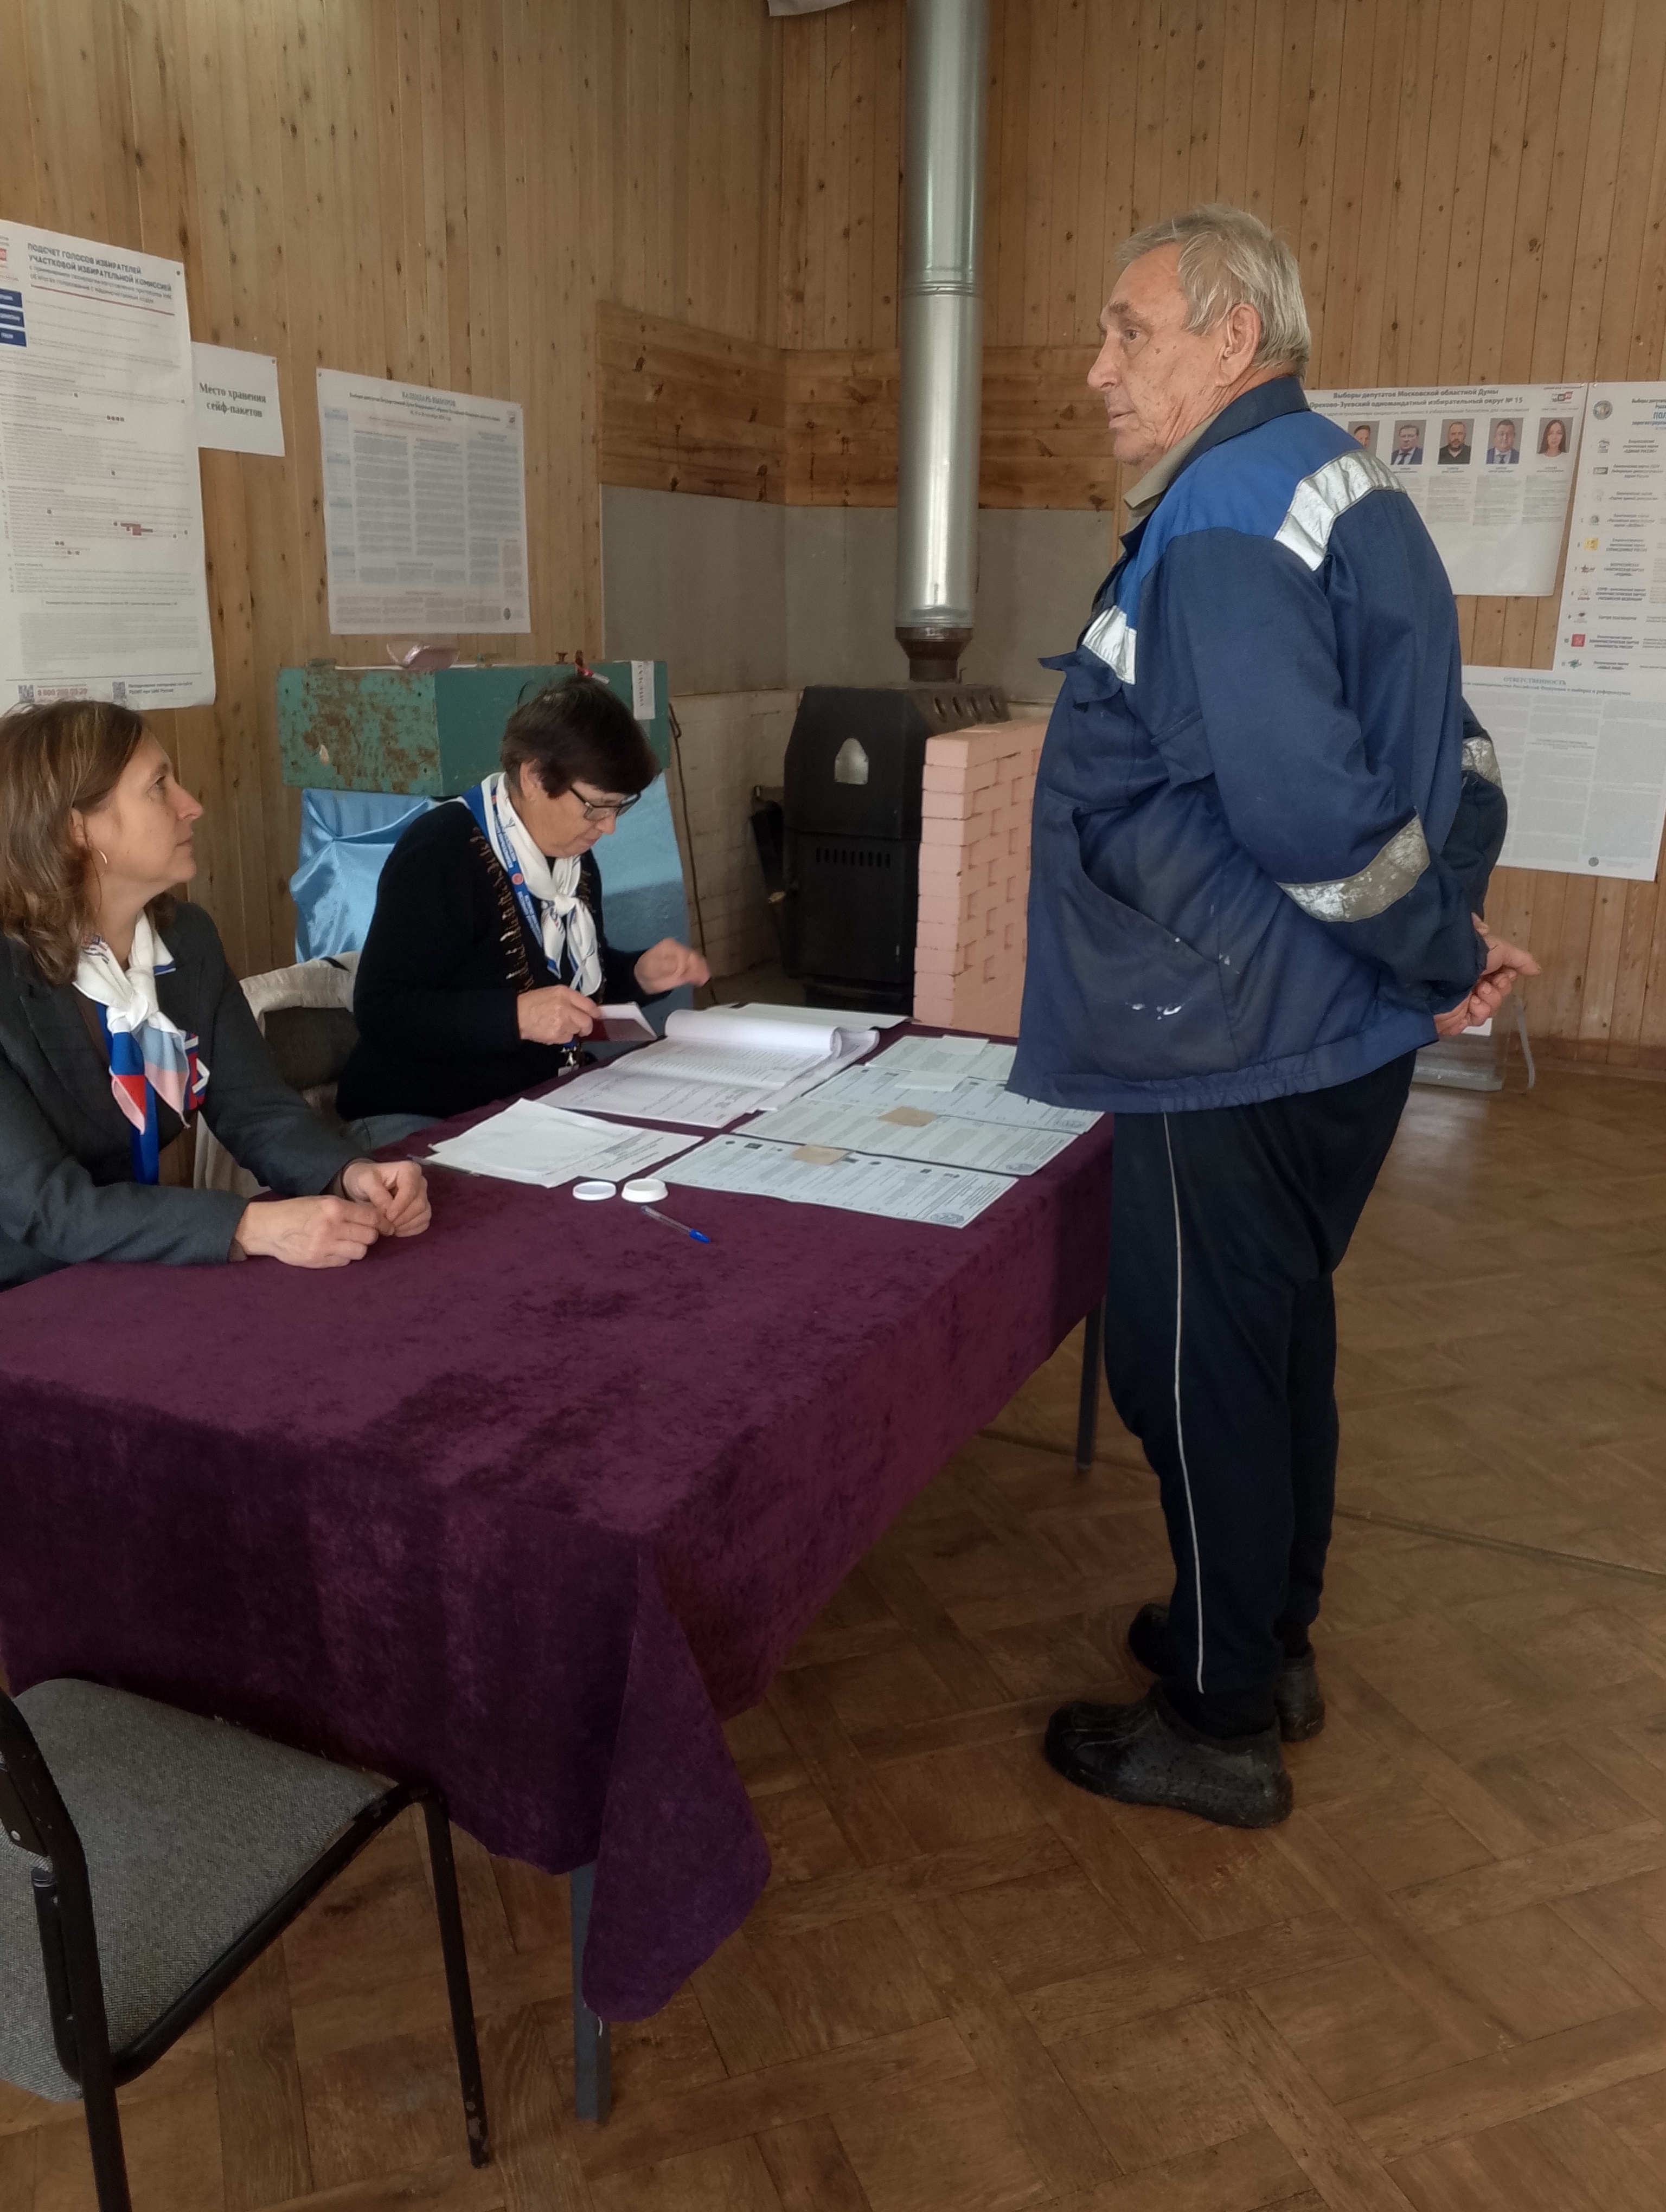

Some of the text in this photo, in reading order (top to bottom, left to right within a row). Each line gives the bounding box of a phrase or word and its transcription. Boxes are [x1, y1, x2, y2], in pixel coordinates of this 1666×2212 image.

[28, 242, 142, 274] ПОДСЧЕТ ГОЛОСОВ ИЗБИРАТЕЛЕЙ
[28, 254, 172, 292] УЧАСТКОВОЙ ИЗБИРАТЕЛЬНОЙ КОМИССИЕЙ
[198, 382, 266, 403] Место хранения
[1478, 388, 1499, 396] Думы
[206, 401, 262, 417] сейф-пакетов
[1309, 401, 1370, 410] Орехово-Зуевский
[1428, 398, 1483, 407] избирательный
